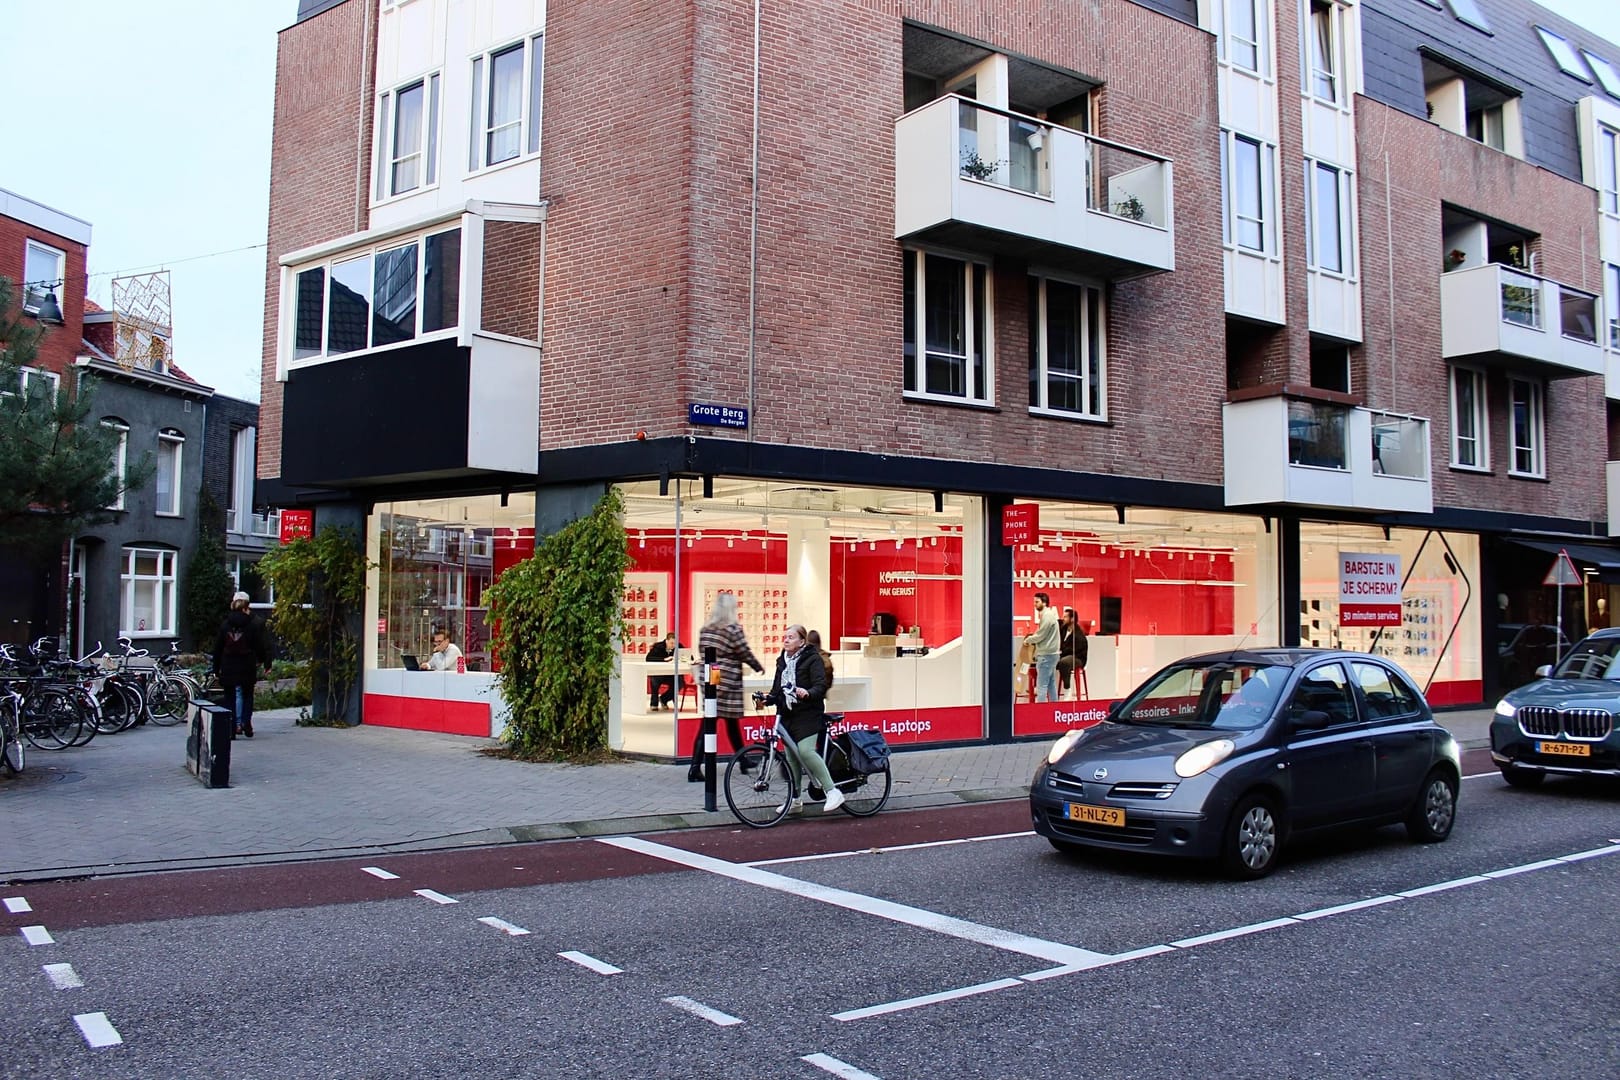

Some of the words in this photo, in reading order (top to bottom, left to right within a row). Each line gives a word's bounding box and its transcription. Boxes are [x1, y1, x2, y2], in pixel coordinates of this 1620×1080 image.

[693, 404, 720, 416] Grote
[722, 407, 744, 420] Berg
[1005, 521, 1027, 529] PHONE
[1014, 532, 1028, 540] LAB
[1345, 561, 1384, 575] BARSTJE
[1386, 562, 1395, 576] IN
[1013, 569, 1073, 589] HONE
[879, 587, 891, 596] PAK
[891, 587, 915, 596] GERUST
[1342, 581, 1354, 594] JE
[1356, 581, 1398, 595] SCHERM?
[1352, 610, 1377, 620] minuten
[1377, 610, 1398, 620] service
[1054, 708, 1106, 724] Reparaties
[882, 719, 931, 736] Laptops
[1544, 743, 1585, 754] R-671-PZ
[1073, 806, 1118, 823] 31-NLZ-9
